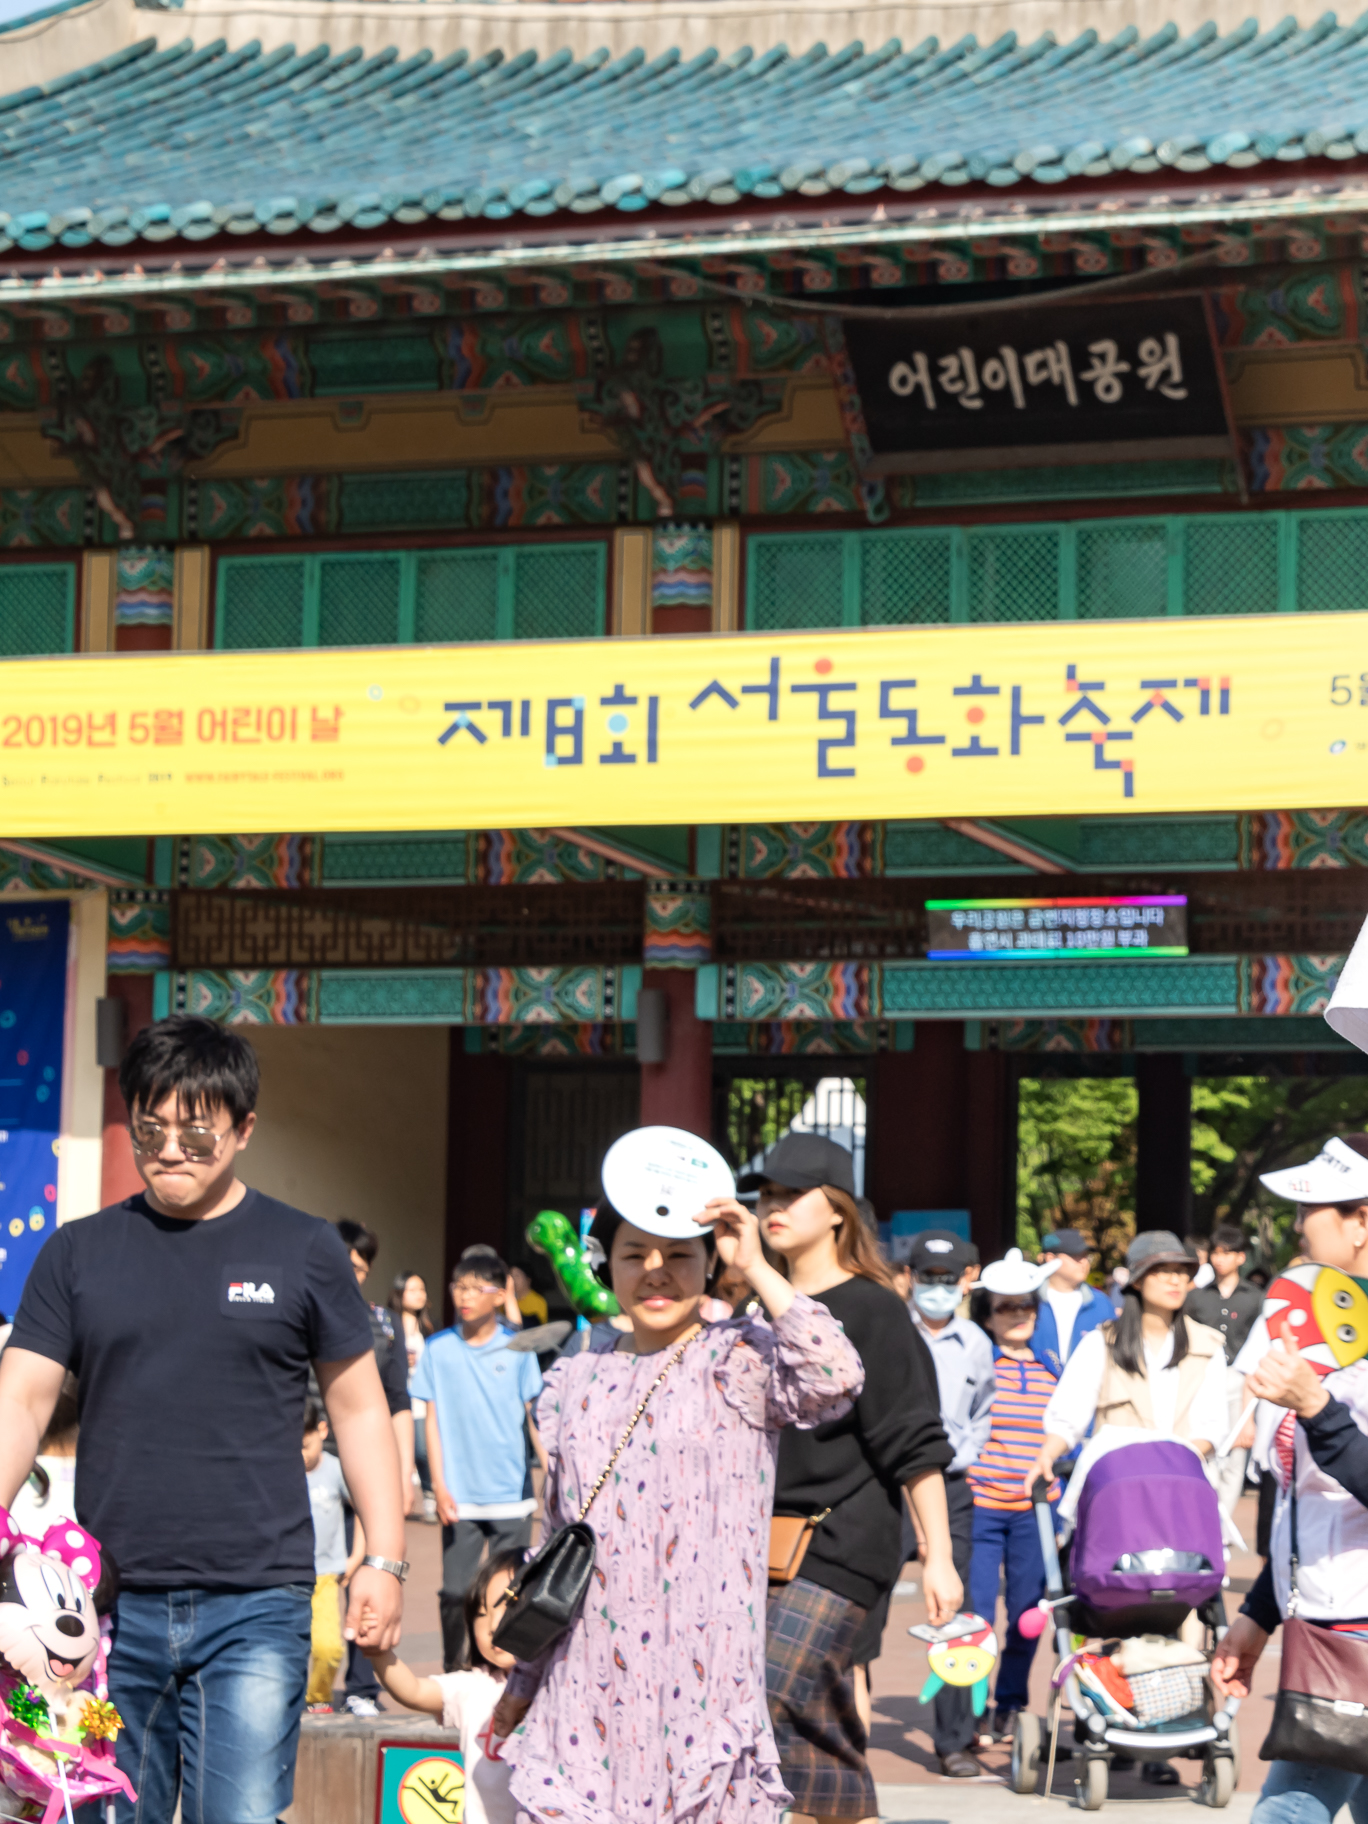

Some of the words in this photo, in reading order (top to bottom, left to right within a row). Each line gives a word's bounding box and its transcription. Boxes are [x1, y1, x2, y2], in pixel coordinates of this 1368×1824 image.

[889, 332, 1188, 410] 어린이대공원
[2, 710, 117, 748] 2019년
[129, 709, 184, 746] 5월
[197, 706, 298, 744] 어린이
[311, 704, 345, 743] 날
[437, 683, 659, 765] 제8회
[689, 656, 1231, 798] 서울동화축제
[228, 1282, 275, 1299] FILA
